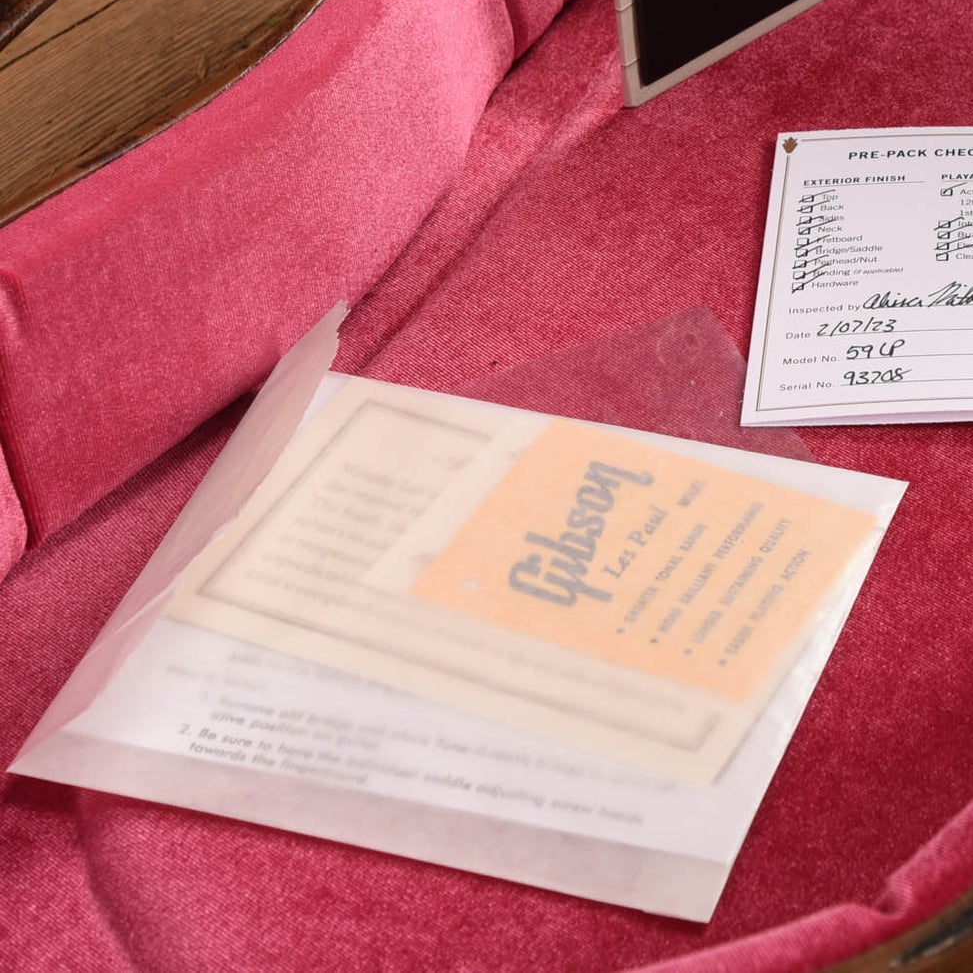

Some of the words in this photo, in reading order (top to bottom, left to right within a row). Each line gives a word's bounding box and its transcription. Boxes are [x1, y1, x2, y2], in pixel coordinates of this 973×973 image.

[848, 148, 928, 160] PRE-PACK
[803, 176, 861, 187] EXTERIOR
[865, 175, 906, 183] FINISH
[820, 203, 844, 212] Back
[817, 225, 843, 233] Neck
[815, 245, 883, 255] Bridge/Saddle
[814, 256, 877, 266] Peghead/Nut
[811, 279, 859, 288] Hardware
[788, 304, 843, 315] Inspected
[847, 304, 861, 313] by
[785, 332, 811, 340] Date
[816, 317, 897, 337] 2/07/23
[782, 355, 817, 365] Model
[821, 355, 841, 363] No.
[846, 345, 873, 360] 59
[779, 382, 812, 391] Serial
[816, 381, 836, 389] No.
[843, 367, 912, 386] 93708
[508, 459, 654, 607] Gibson
[602, 549, 636, 580] Les
[628, 504, 668, 548] Paul
